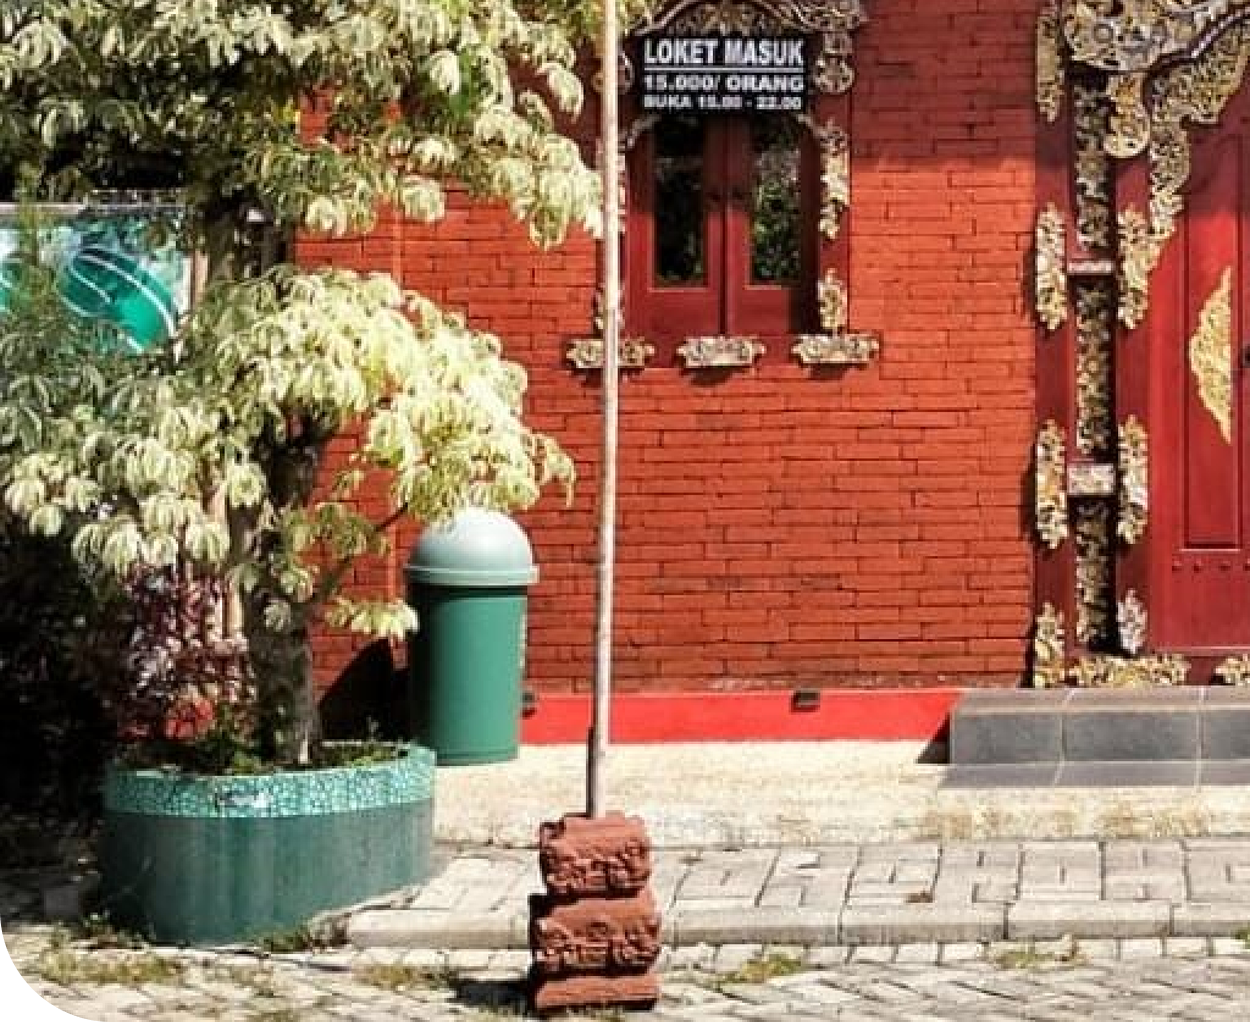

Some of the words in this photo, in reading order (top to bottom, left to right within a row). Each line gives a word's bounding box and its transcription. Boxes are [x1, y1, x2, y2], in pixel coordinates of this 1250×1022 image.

[644, 38, 719, 64] LOKET
[725, 38, 804, 65] MASUK
[727, 74, 804, 91] ORANG
